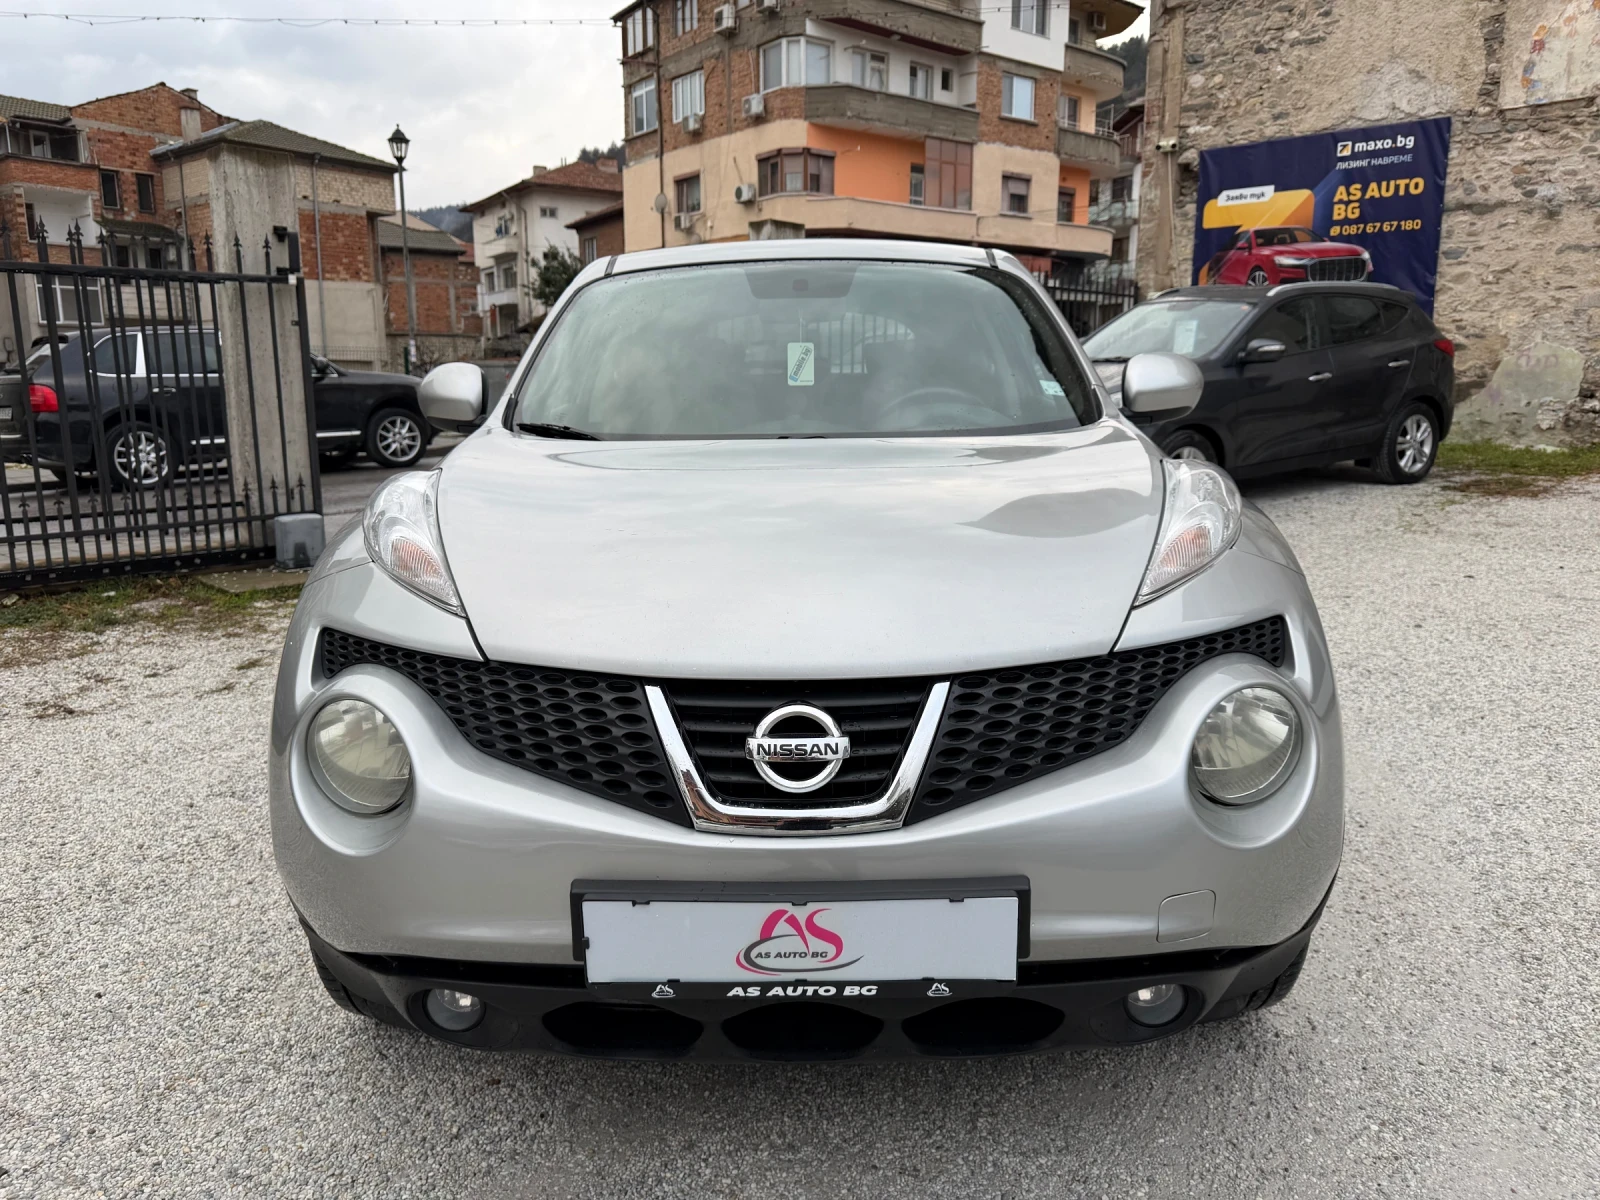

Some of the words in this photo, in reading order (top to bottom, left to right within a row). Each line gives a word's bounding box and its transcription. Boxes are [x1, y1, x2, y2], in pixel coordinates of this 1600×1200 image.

[1354, 135, 1415, 153] maxo.bg
[1335, 159, 1370, 170] ЛИЗИНГ
[1371, 154, 1413, 166] НАВРЕМЕ
[1333, 183, 1362, 202] AS
[1364, 177, 1425, 199] AUTO
[1332, 202, 1360, 220] BG
[1342, 224, 1364, 235] 087
[1366, 222, 1380, 233] 67
[1382, 221, 1398, 232] 67
[1400, 219, 1422, 230] 180
[756, 743, 839, 756] NISSAN
[760, 908, 844, 963] AS
[755, 951, 771, 959] AS
[774, 951, 807, 959] AUTO
[726, 986, 761, 997] AS
[766, 986, 837, 997] AUTO
[843, 986, 878, 996] BG
